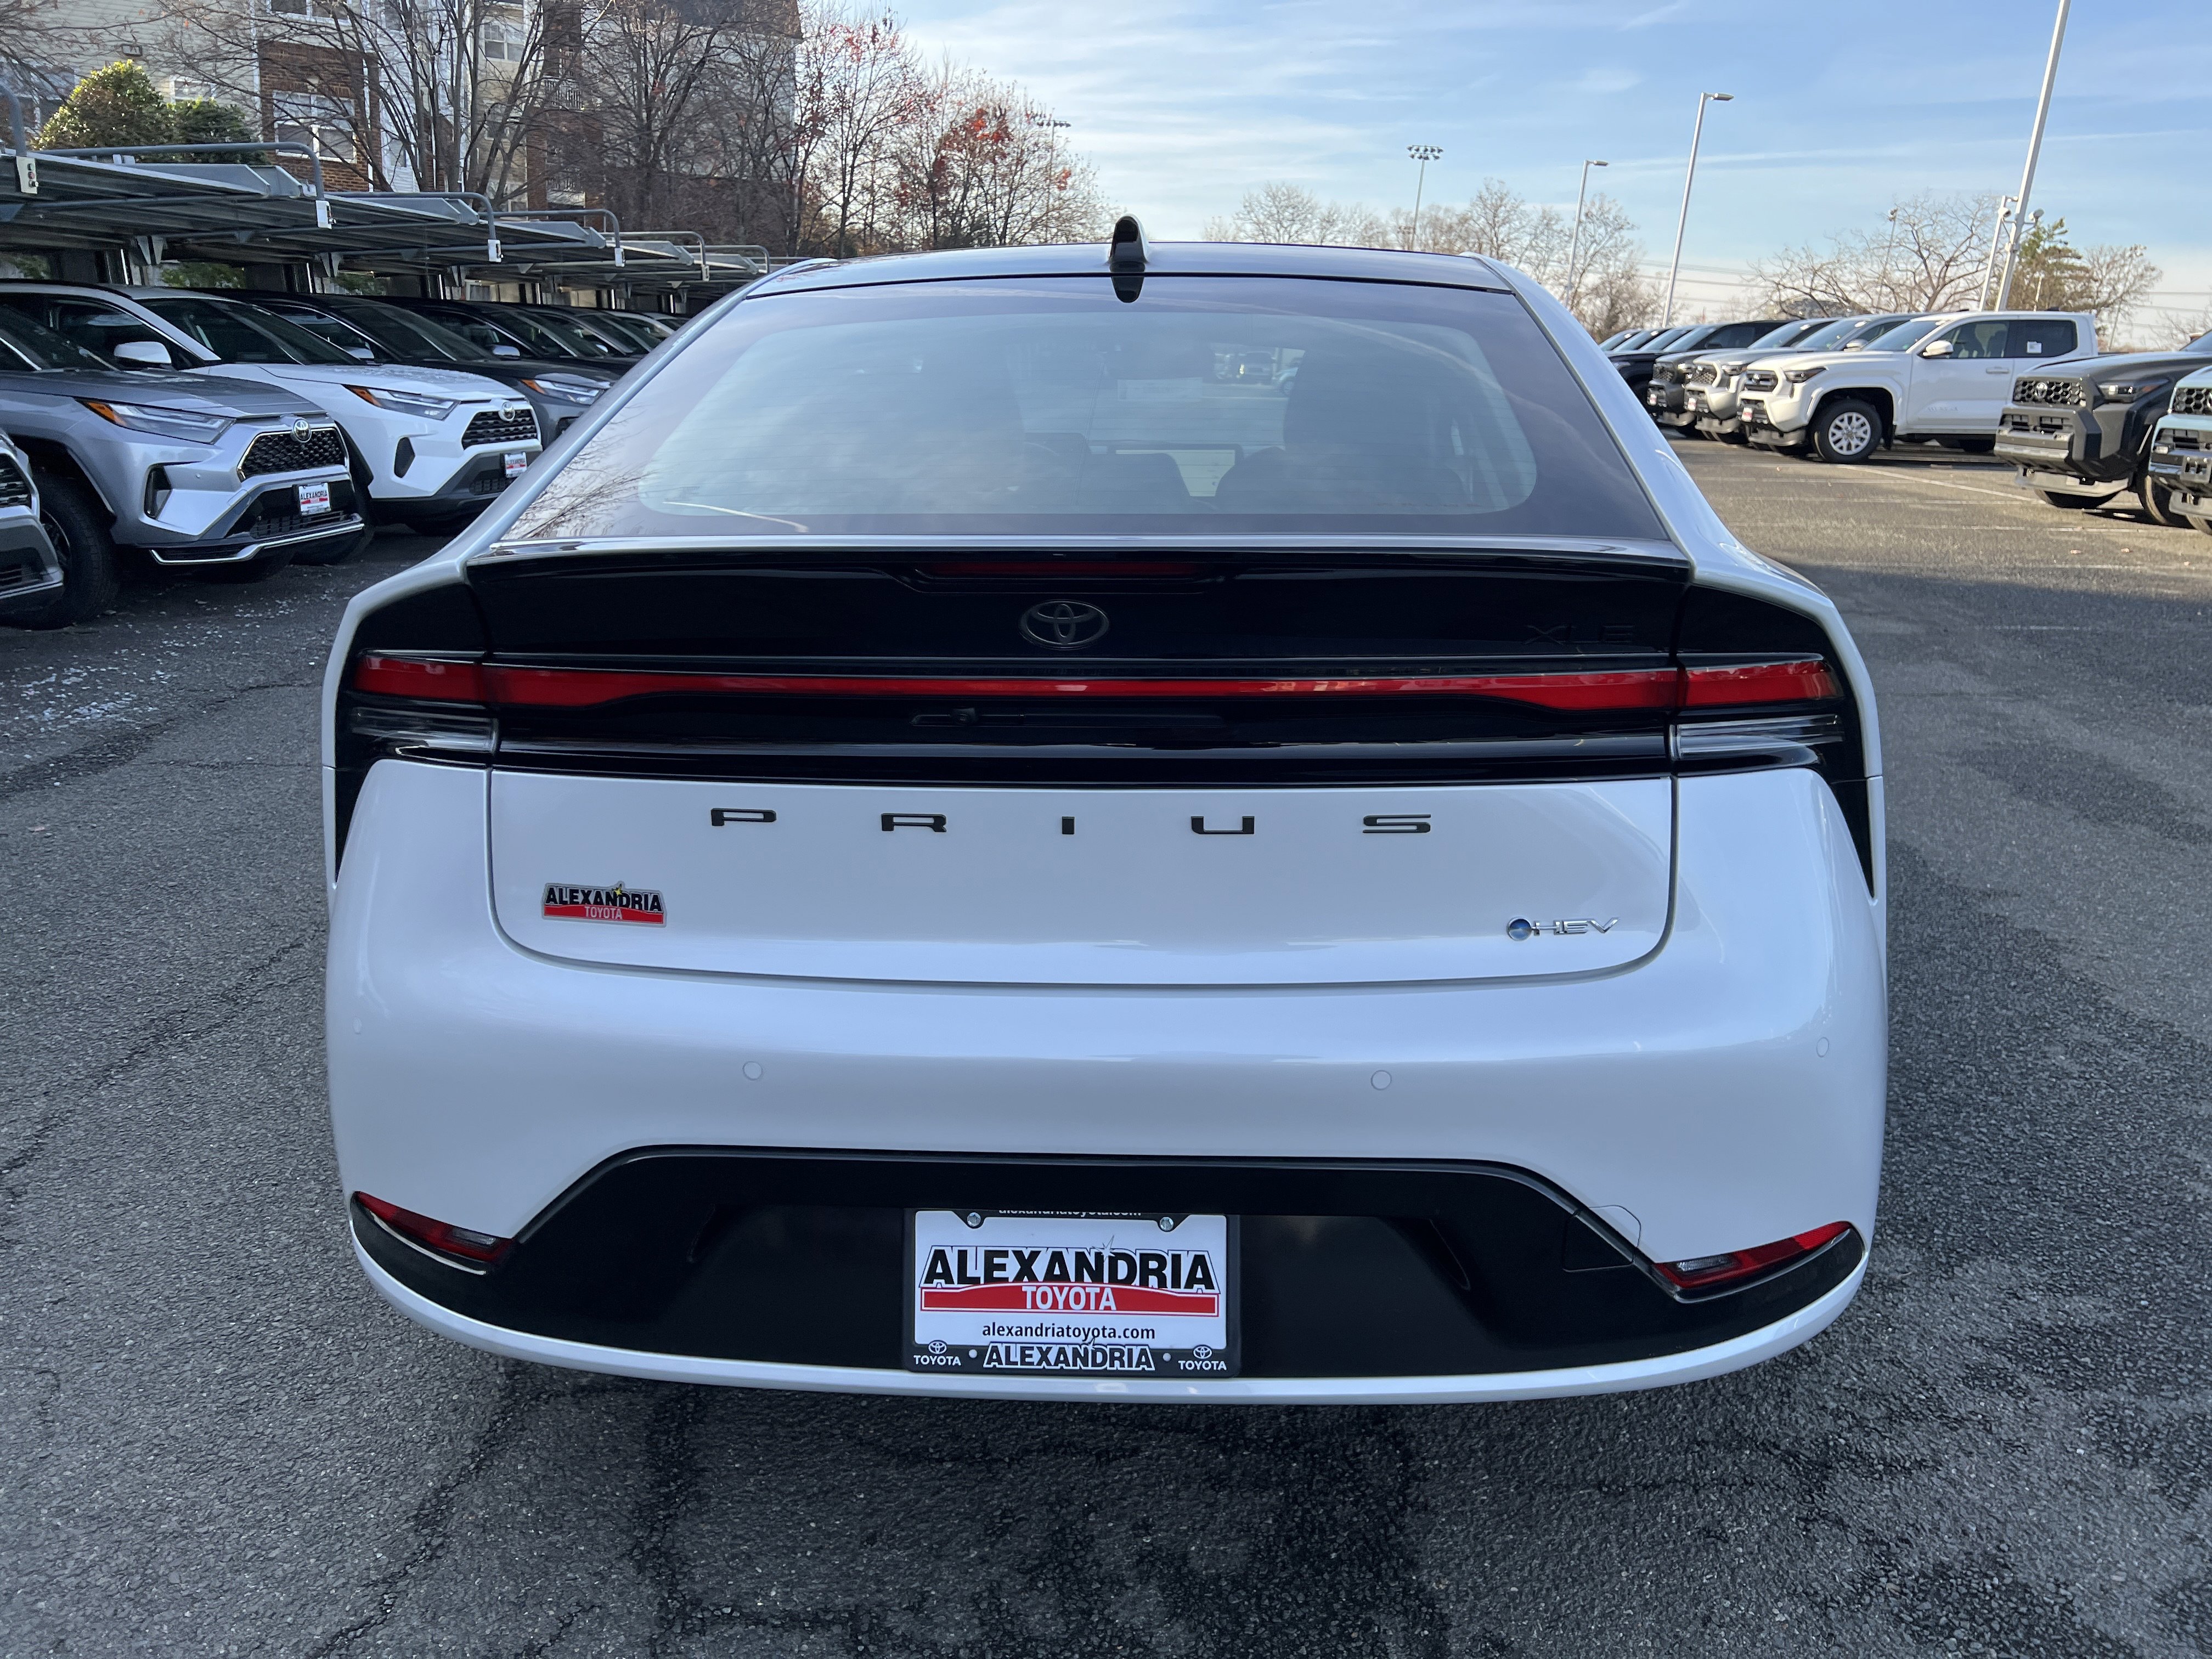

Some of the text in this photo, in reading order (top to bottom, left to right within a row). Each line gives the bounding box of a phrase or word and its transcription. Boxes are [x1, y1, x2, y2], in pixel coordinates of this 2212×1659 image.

[1523, 624, 1634, 645] XLE
[711, 808, 1432, 835] PRIUS
[545, 887, 663, 912] ALEXANDRIA
[585, 906, 623, 920] TOYOTA
[1534, 916, 1619, 936] HEV
[922, 1248, 1217, 1291] ALEXANDRIA
[1022, 1286, 1116, 1311] TOYOTA
[983, 1322, 1155, 1341] alexandriatoyota.com
[913, 1355, 962, 1367] TOYOTA
[984, 1343, 1155, 1370] ALEXANDRIA
[1178, 1359, 1227, 1371] TOYOTA
